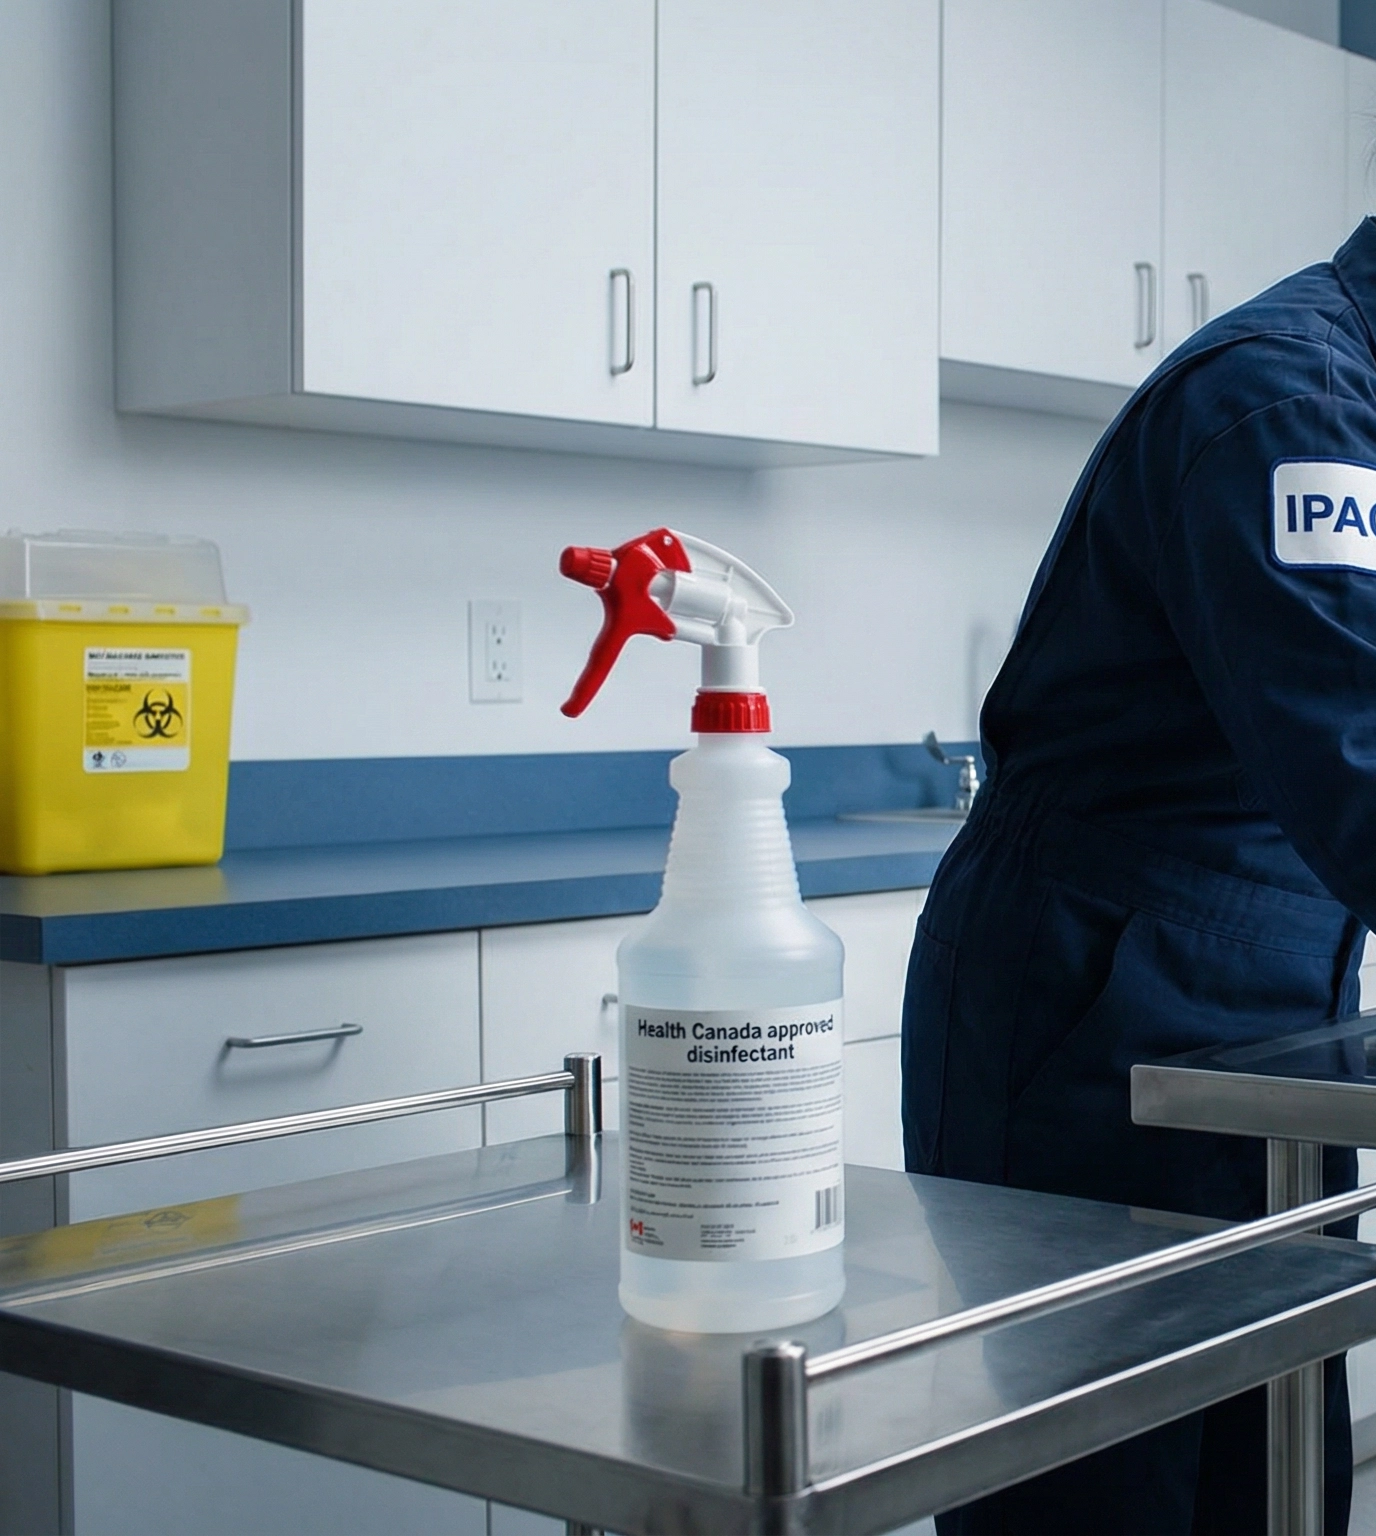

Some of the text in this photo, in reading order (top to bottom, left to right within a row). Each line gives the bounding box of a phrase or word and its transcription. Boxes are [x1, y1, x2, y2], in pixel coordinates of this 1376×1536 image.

[637, 1014, 834, 1041] Health Canada approved
[687, 1043, 795, 1063] disinfectant
